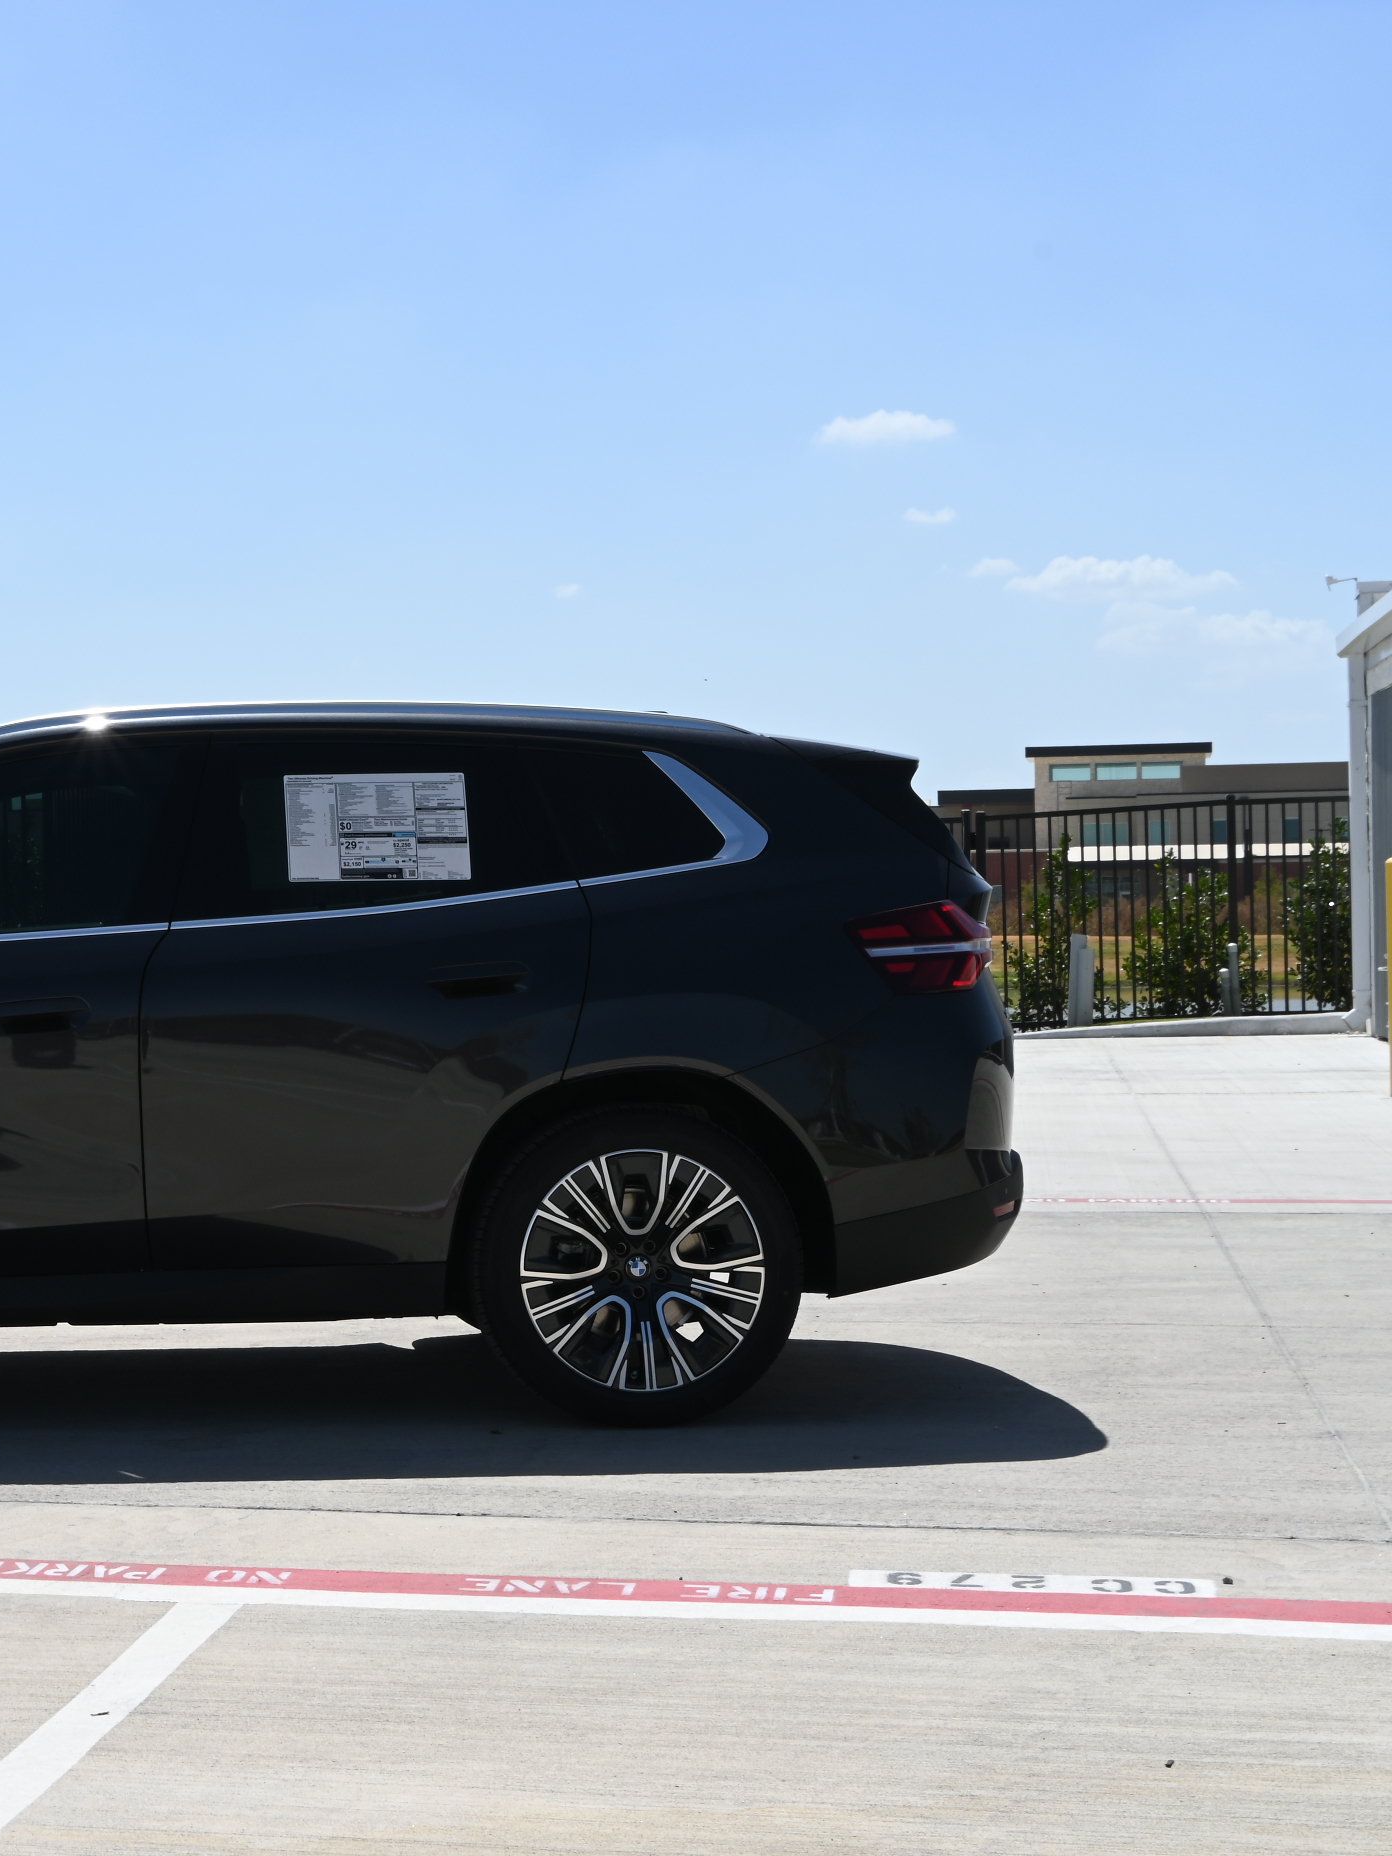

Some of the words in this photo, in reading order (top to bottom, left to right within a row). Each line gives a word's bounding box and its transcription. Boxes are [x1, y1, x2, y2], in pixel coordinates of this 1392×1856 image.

[339, 822, 352, 831] $0
[345, 841, 357, 849] 29
[205, 1568, 292, 1585] NO
[459, 1578, 637, 1596] LANE
[680, 1584, 835, 1603] FIRE
